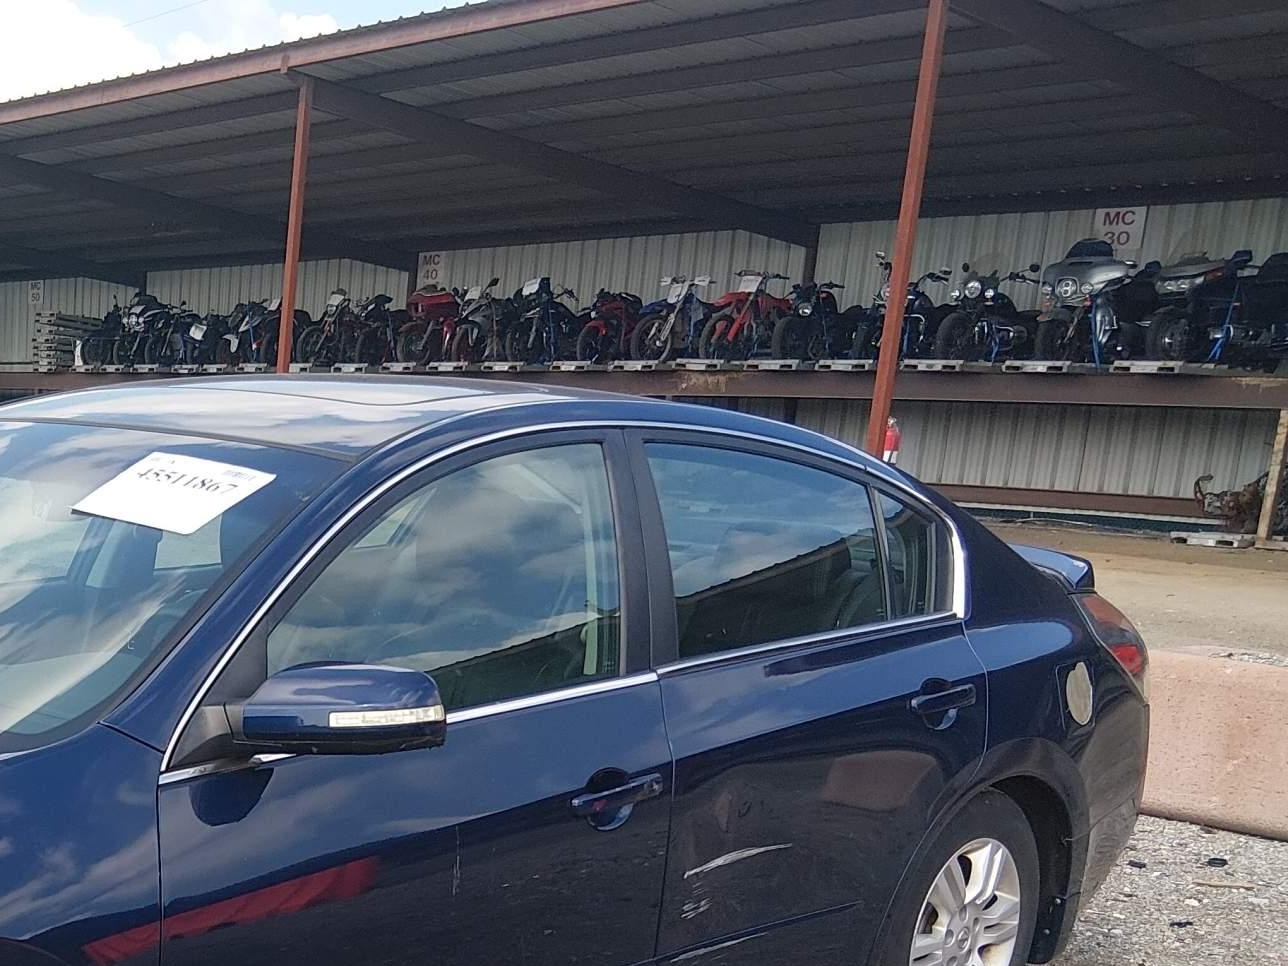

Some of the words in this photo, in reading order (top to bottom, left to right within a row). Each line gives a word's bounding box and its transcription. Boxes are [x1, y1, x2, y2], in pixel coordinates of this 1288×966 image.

[1103, 210, 1137, 226] MC
[1103, 231, 1130, 246] 30
[423, 254, 441, 266] MC
[423, 269, 438, 280] 40
[137, 468, 240, 494] 45511867
